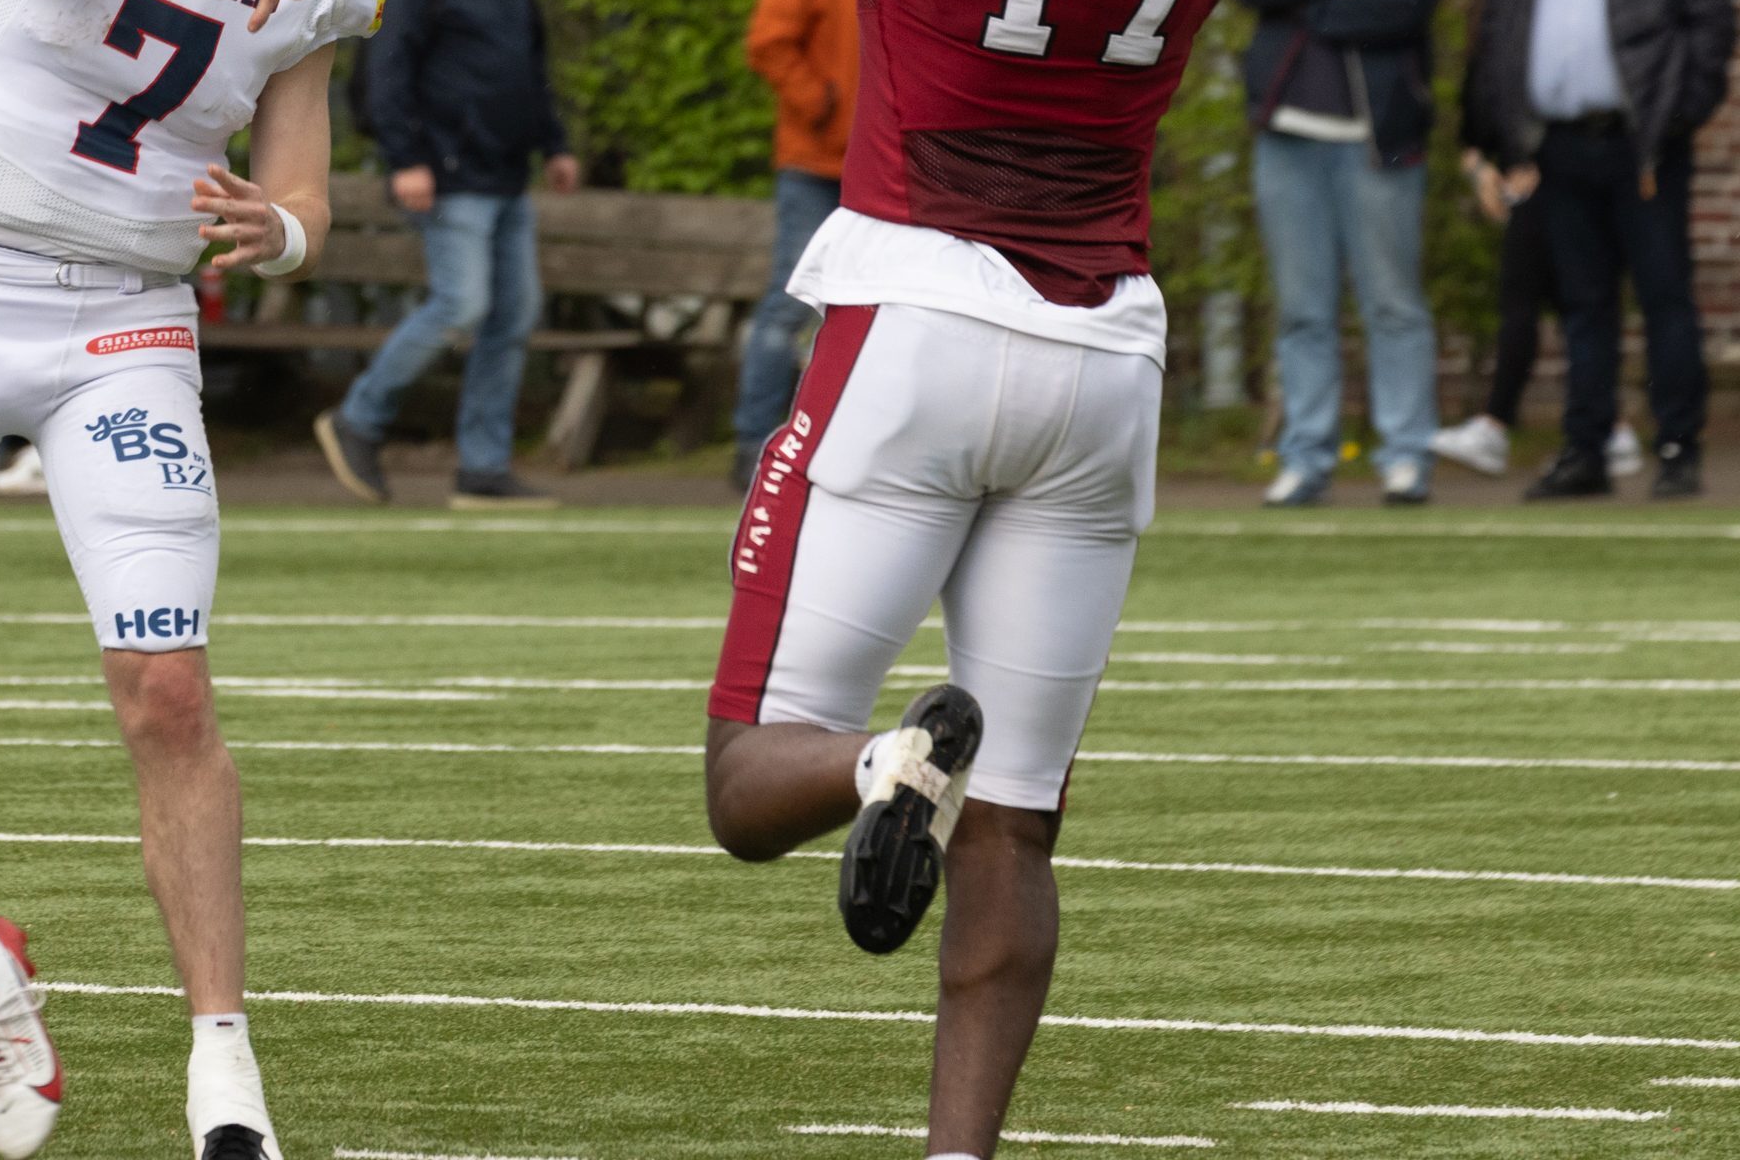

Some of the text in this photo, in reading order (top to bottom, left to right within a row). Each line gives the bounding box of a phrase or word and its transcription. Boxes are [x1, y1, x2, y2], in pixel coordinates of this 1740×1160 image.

[85, 407, 149, 442] yes
[111, 423, 188, 462] BS
[158, 463, 212, 491] BZ
[115, 607, 199, 639] HEH
